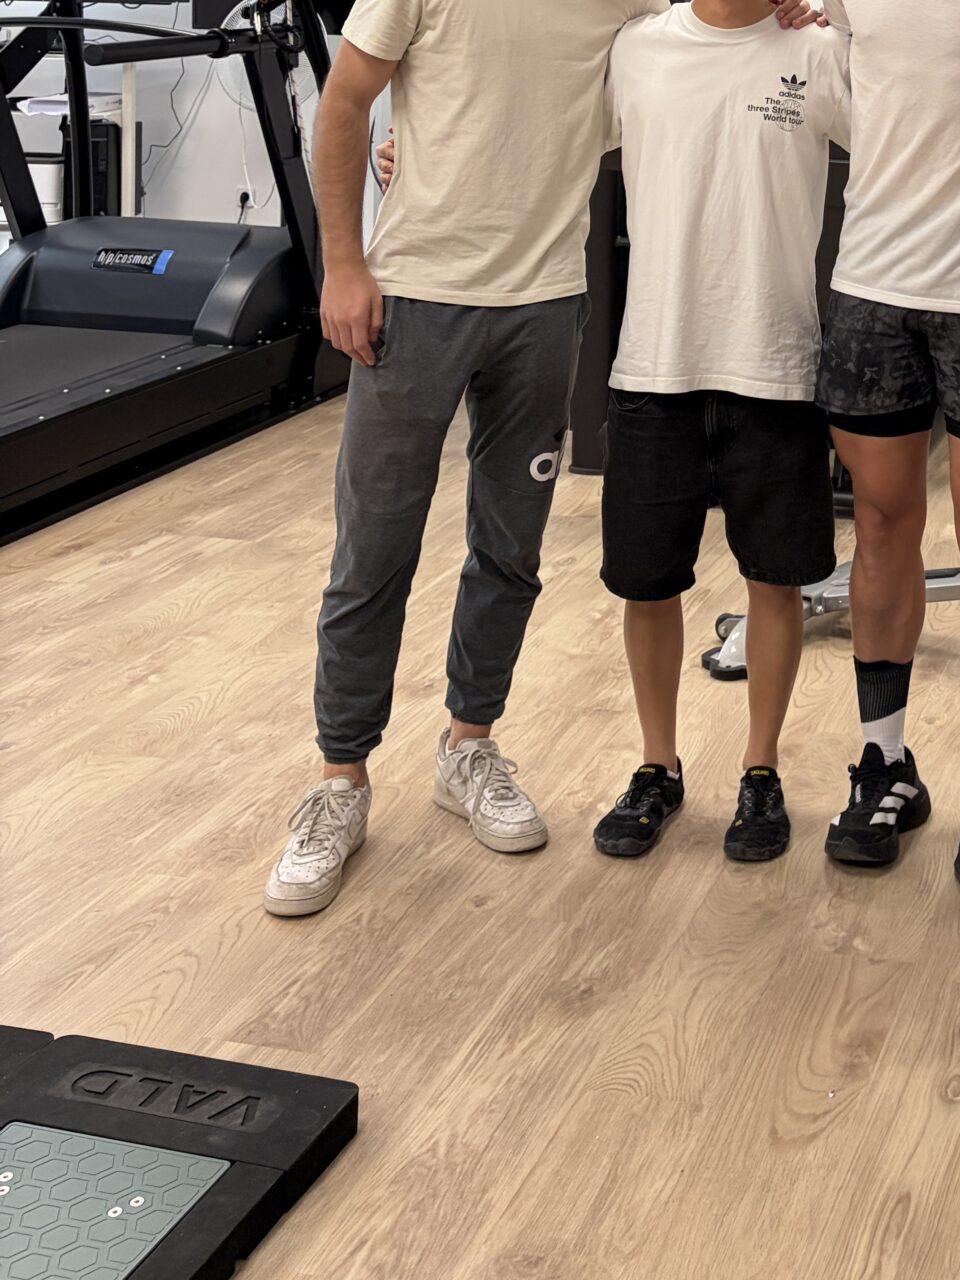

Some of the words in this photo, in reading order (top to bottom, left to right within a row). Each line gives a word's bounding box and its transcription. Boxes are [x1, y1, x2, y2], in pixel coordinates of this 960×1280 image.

[764, 97, 781, 106] The
[778, 90, 805, 101] adidas
[747, 104, 770, 113] three
[771, 106, 801, 117] Stripes
[763, 113, 787, 123] World
[789, 117, 804, 126] tour
[71, 1070, 261, 1127] VALD
